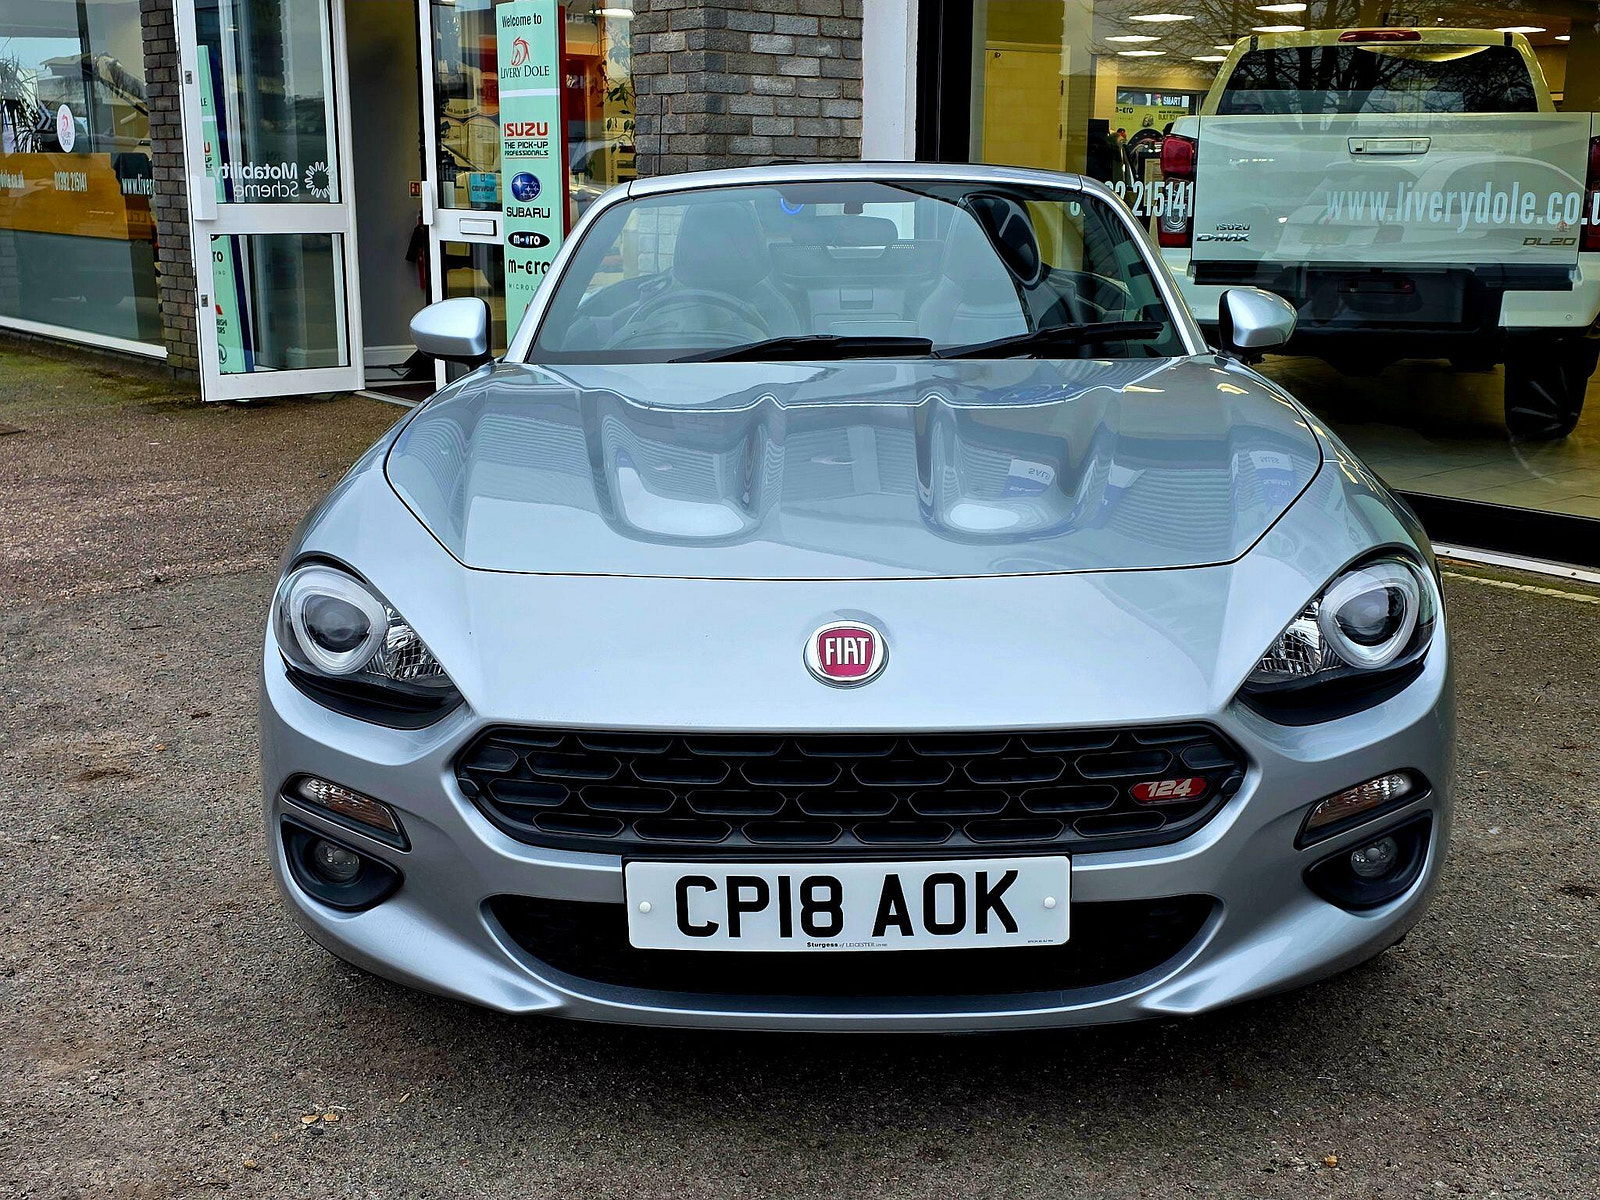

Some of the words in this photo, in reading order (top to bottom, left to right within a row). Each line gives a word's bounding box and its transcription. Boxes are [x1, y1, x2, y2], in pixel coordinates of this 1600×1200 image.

[502, 14, 531, 28] Welcome
[533, 13, 542, 25] to
[501, 67, 522, 79] LIVERY
[524, 65, 550, 77] DOLE
[504, 122, 548, 137] ISUZU
[518, 141, 549, 149] PICK-UP
[1133, 181, 1194, 217] 215141
[506, 206, 551, 218] SUBARU
[1216, 223, 1251, 231] ISUZU
[1196, 233, 1250, 242] D-MAX
[1522, 237, 1578, 246] DL20
[825, 637, 870, 666] FIAT
[1147, 778, 1193, 798] 124
[675, 874, 844, 938] CP18
[871, 870, 1019, 937] AOK
